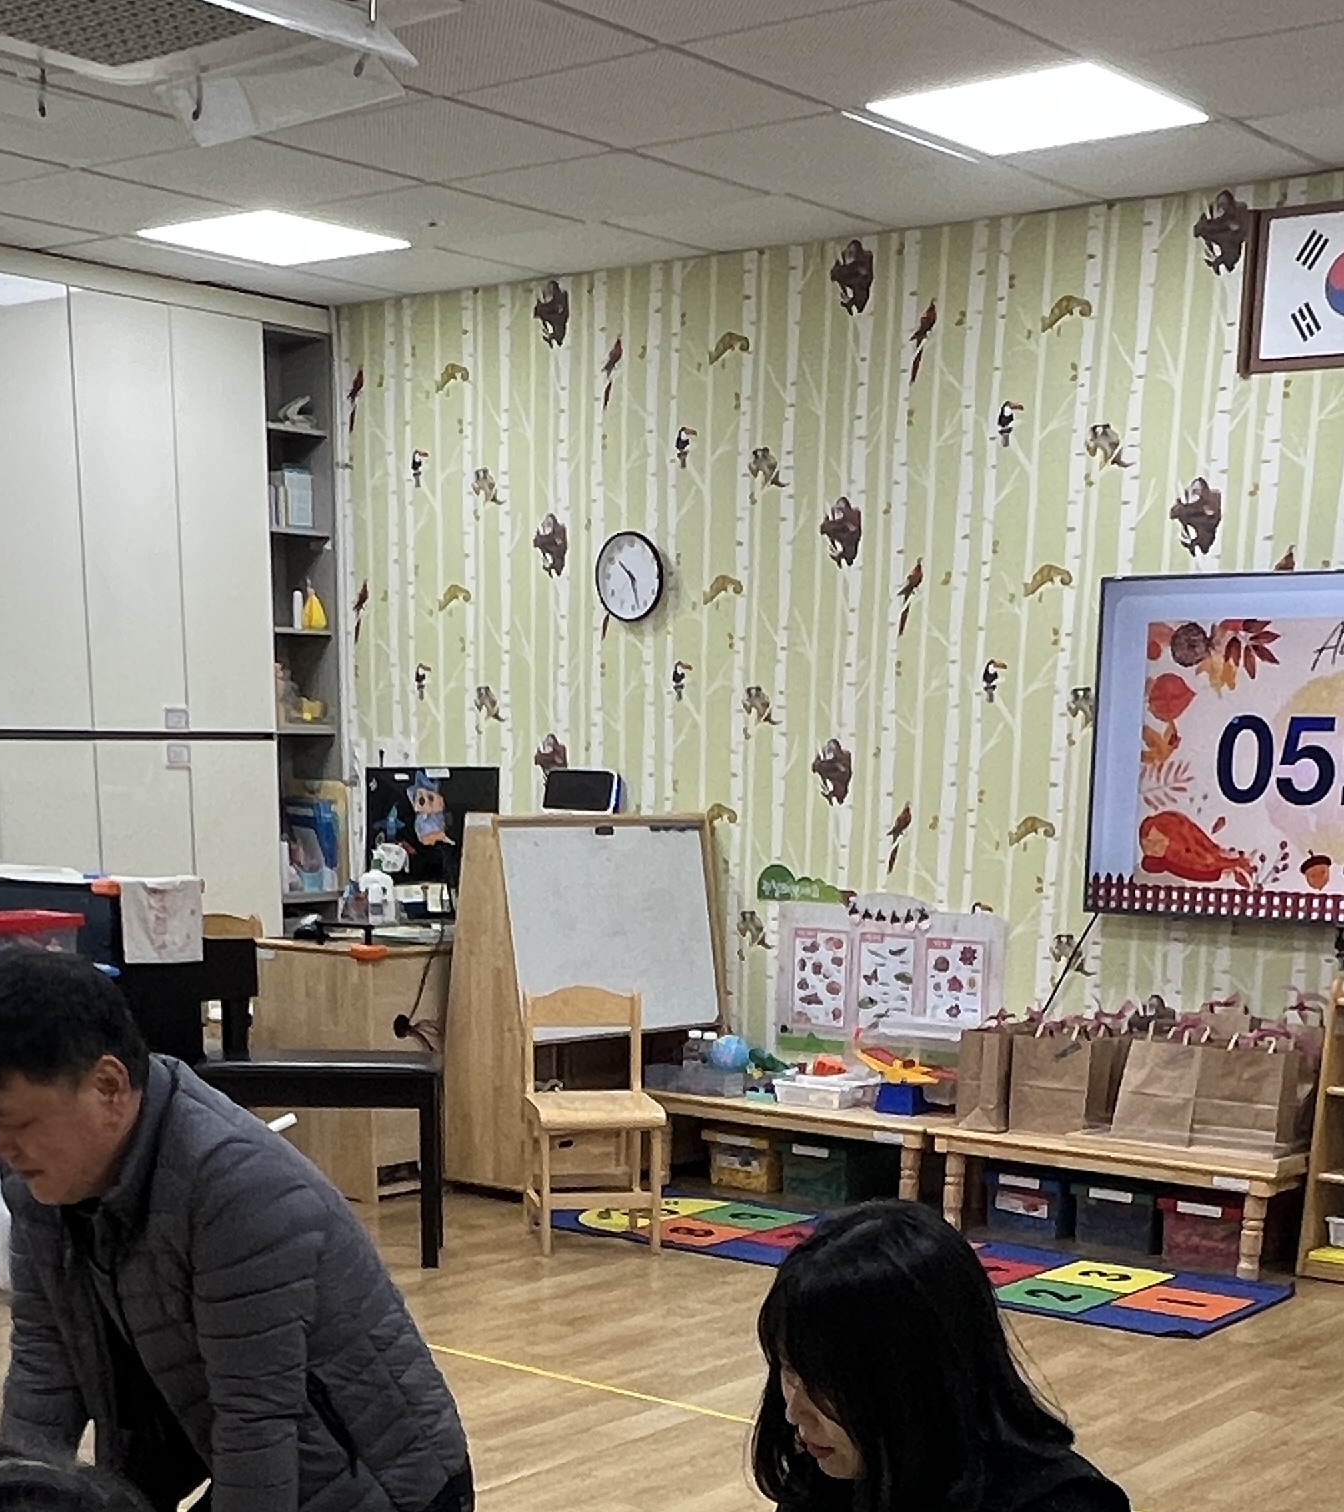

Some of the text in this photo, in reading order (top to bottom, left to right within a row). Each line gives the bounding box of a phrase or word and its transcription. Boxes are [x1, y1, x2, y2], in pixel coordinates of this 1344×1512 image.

[669, 1226, 715, 1238] 8
[1079, 1269, 1132, 1282] 3
[1024, 1288, 1083, 1303] 2
